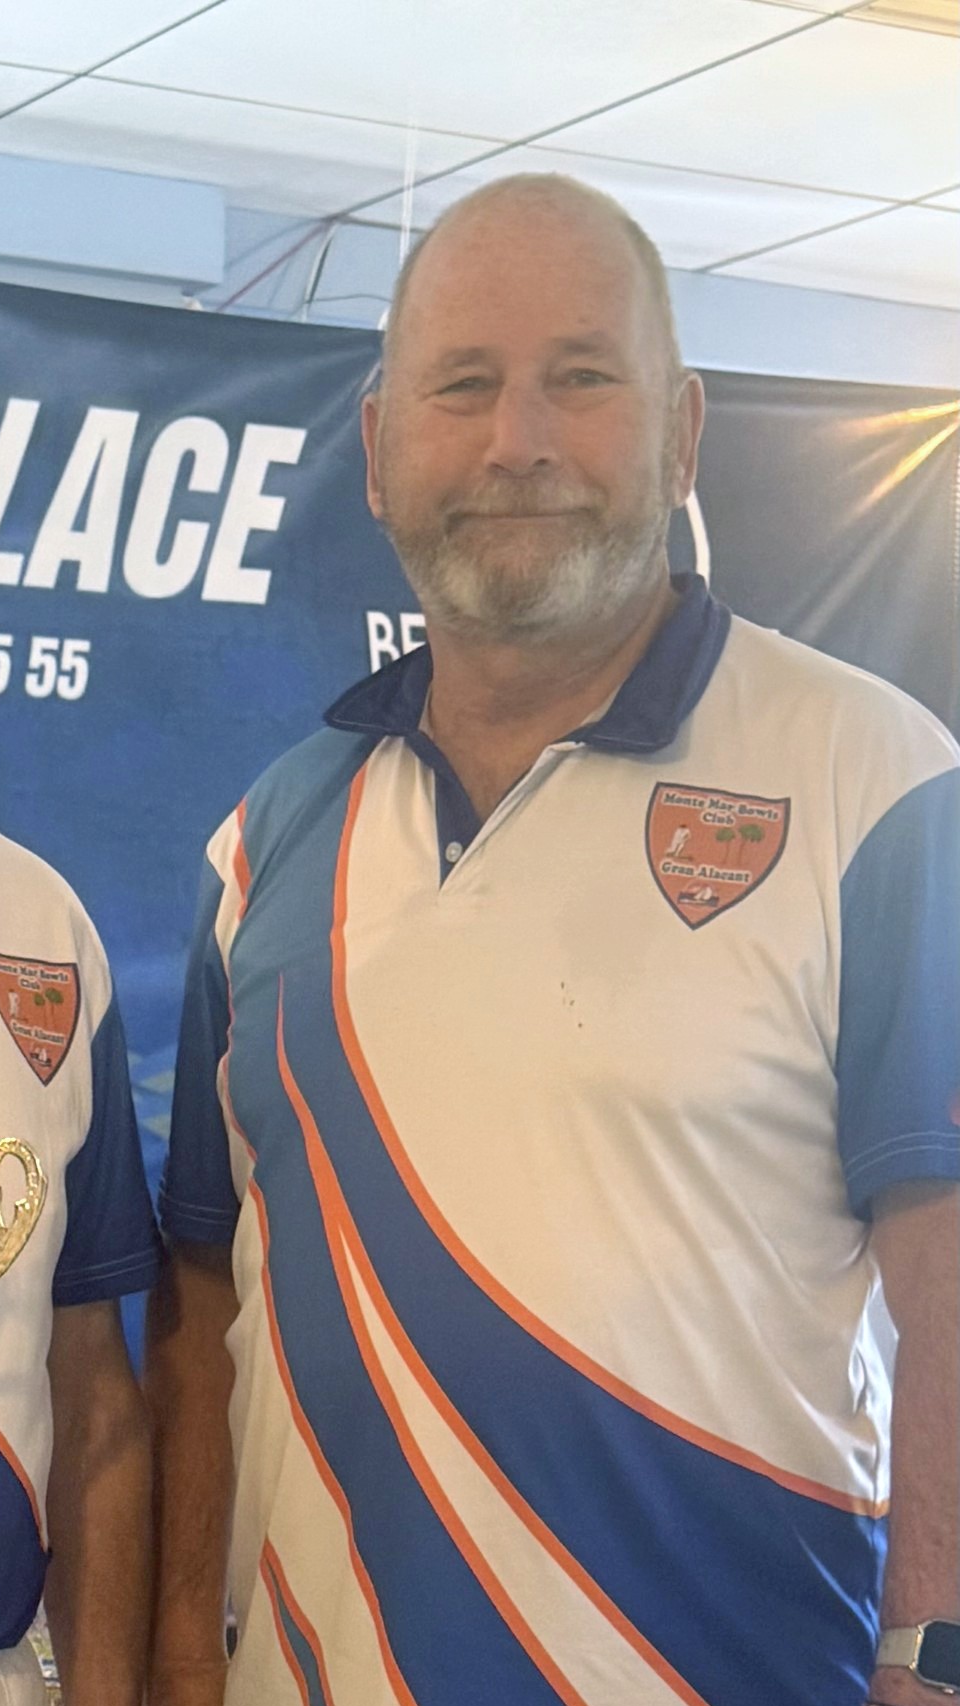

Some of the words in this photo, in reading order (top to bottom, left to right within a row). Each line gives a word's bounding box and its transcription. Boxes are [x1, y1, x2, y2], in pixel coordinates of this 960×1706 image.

[25, 636, 91, 701] 55
[663, 792, 705, 808] Monte
[708, 799, 734, 812] Mar
[738, 804, 778, 820] Bowls
[702, 812, 735, 826] Club
[661, 861, 695, 877] Gran
